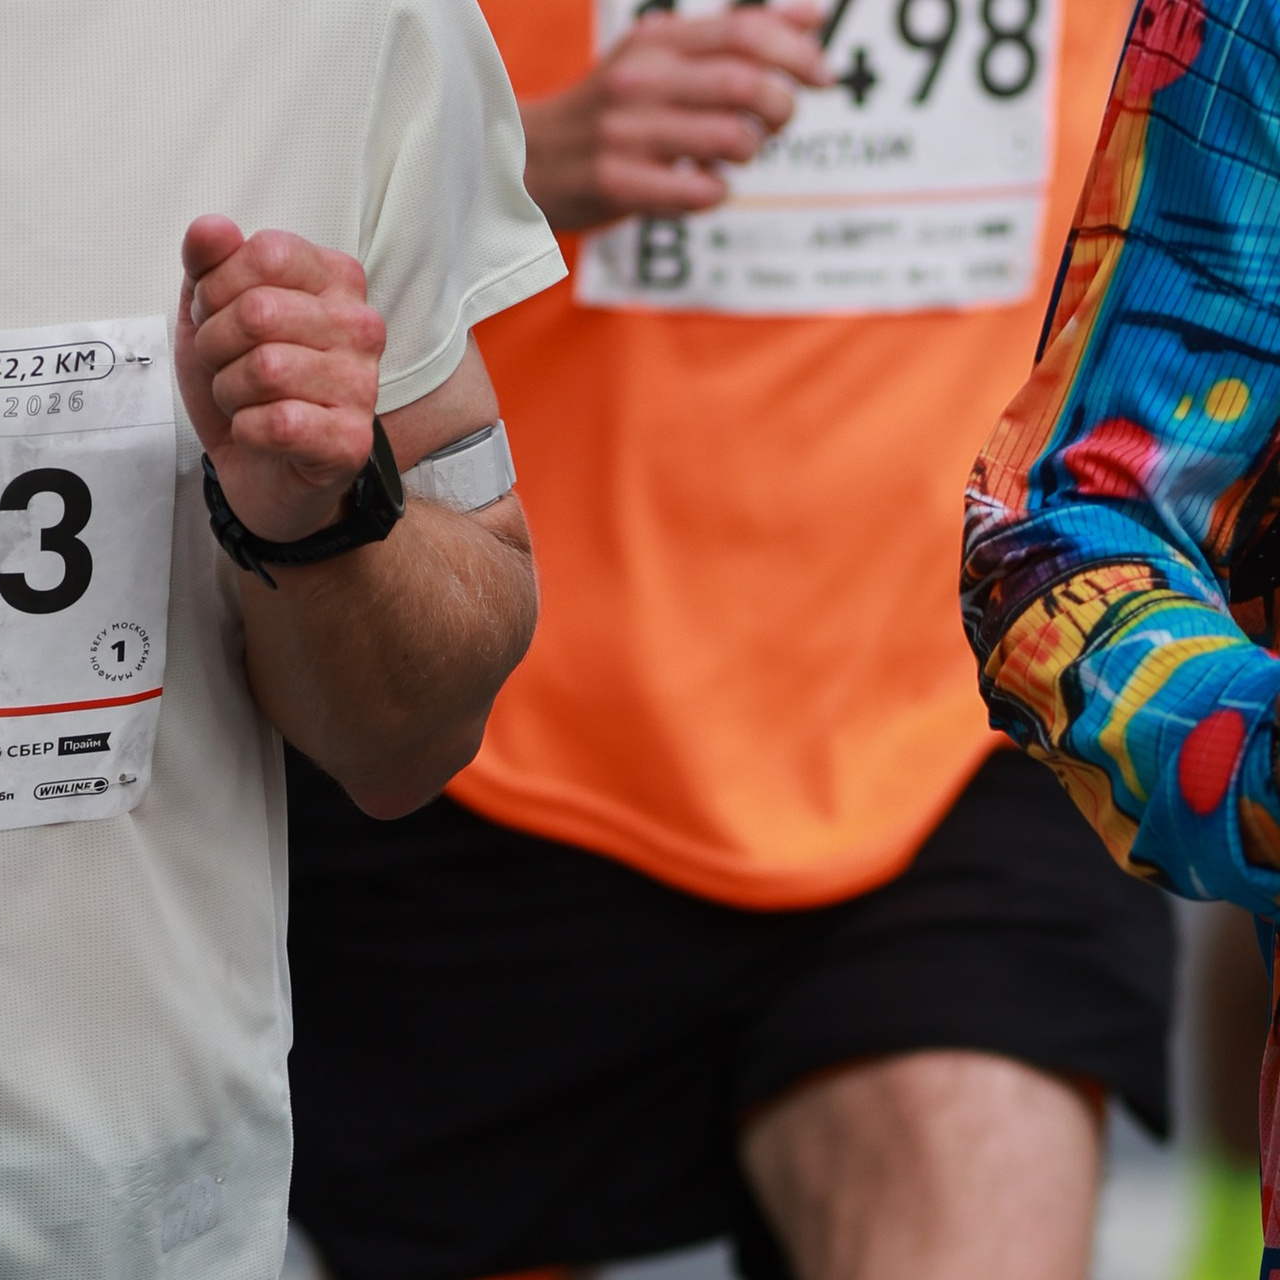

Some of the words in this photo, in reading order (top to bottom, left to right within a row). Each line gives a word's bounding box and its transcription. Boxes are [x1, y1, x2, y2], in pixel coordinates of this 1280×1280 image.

[54, 348, 97, 375] КМ
[3, 390, 85, 418] 2026
[110, 640, 126, 663] 1
[111, 621, 151, 671] МОСКОВСКИЙ
[89, 655, 133, 682] МАРАФОН
[7, 741, 54, 758] СБЕР
[63, 738, 102, 752] Прайм
[39, 781, 93, 797] WINLINE
